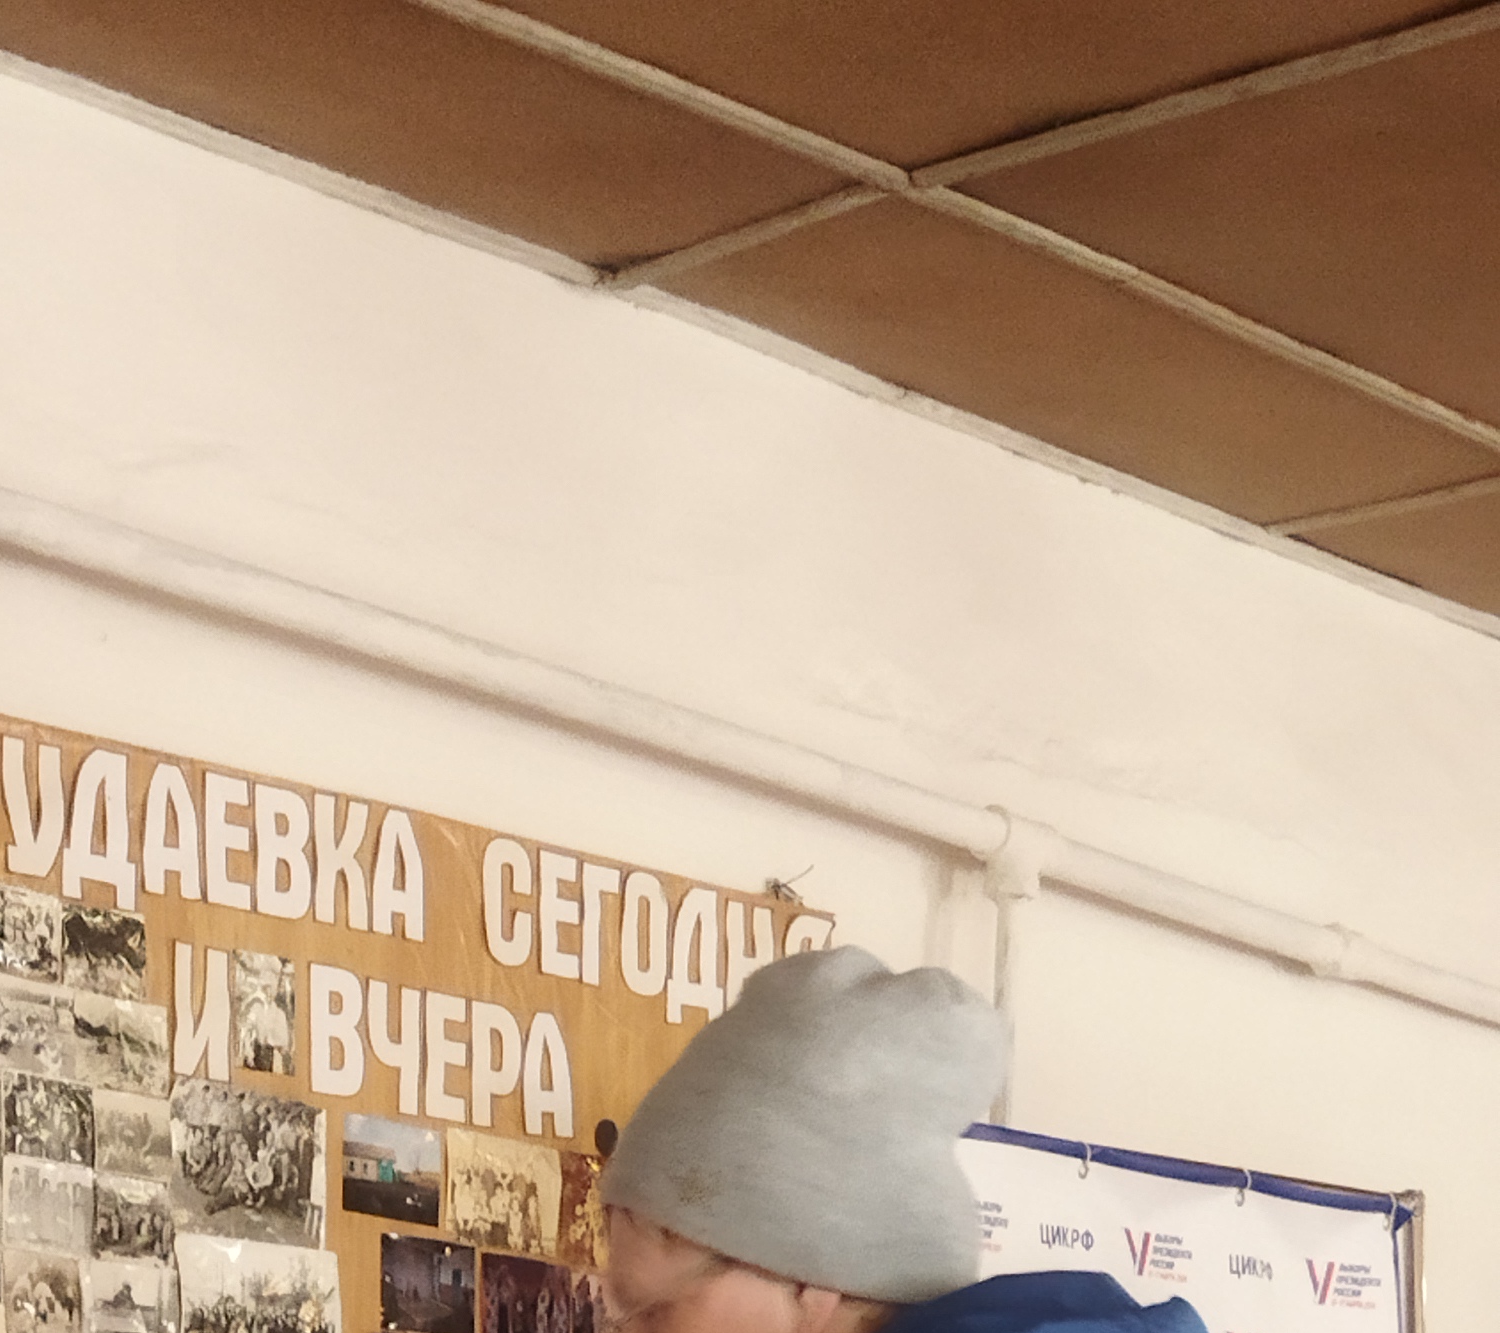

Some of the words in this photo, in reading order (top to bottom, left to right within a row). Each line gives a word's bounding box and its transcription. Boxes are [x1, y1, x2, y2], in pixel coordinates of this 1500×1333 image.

[481, 837, 834, 1024] СЕГОДН
[173, 940, 232, 1083] И
[309, 962, 573, 1139] ВЧЕРА
